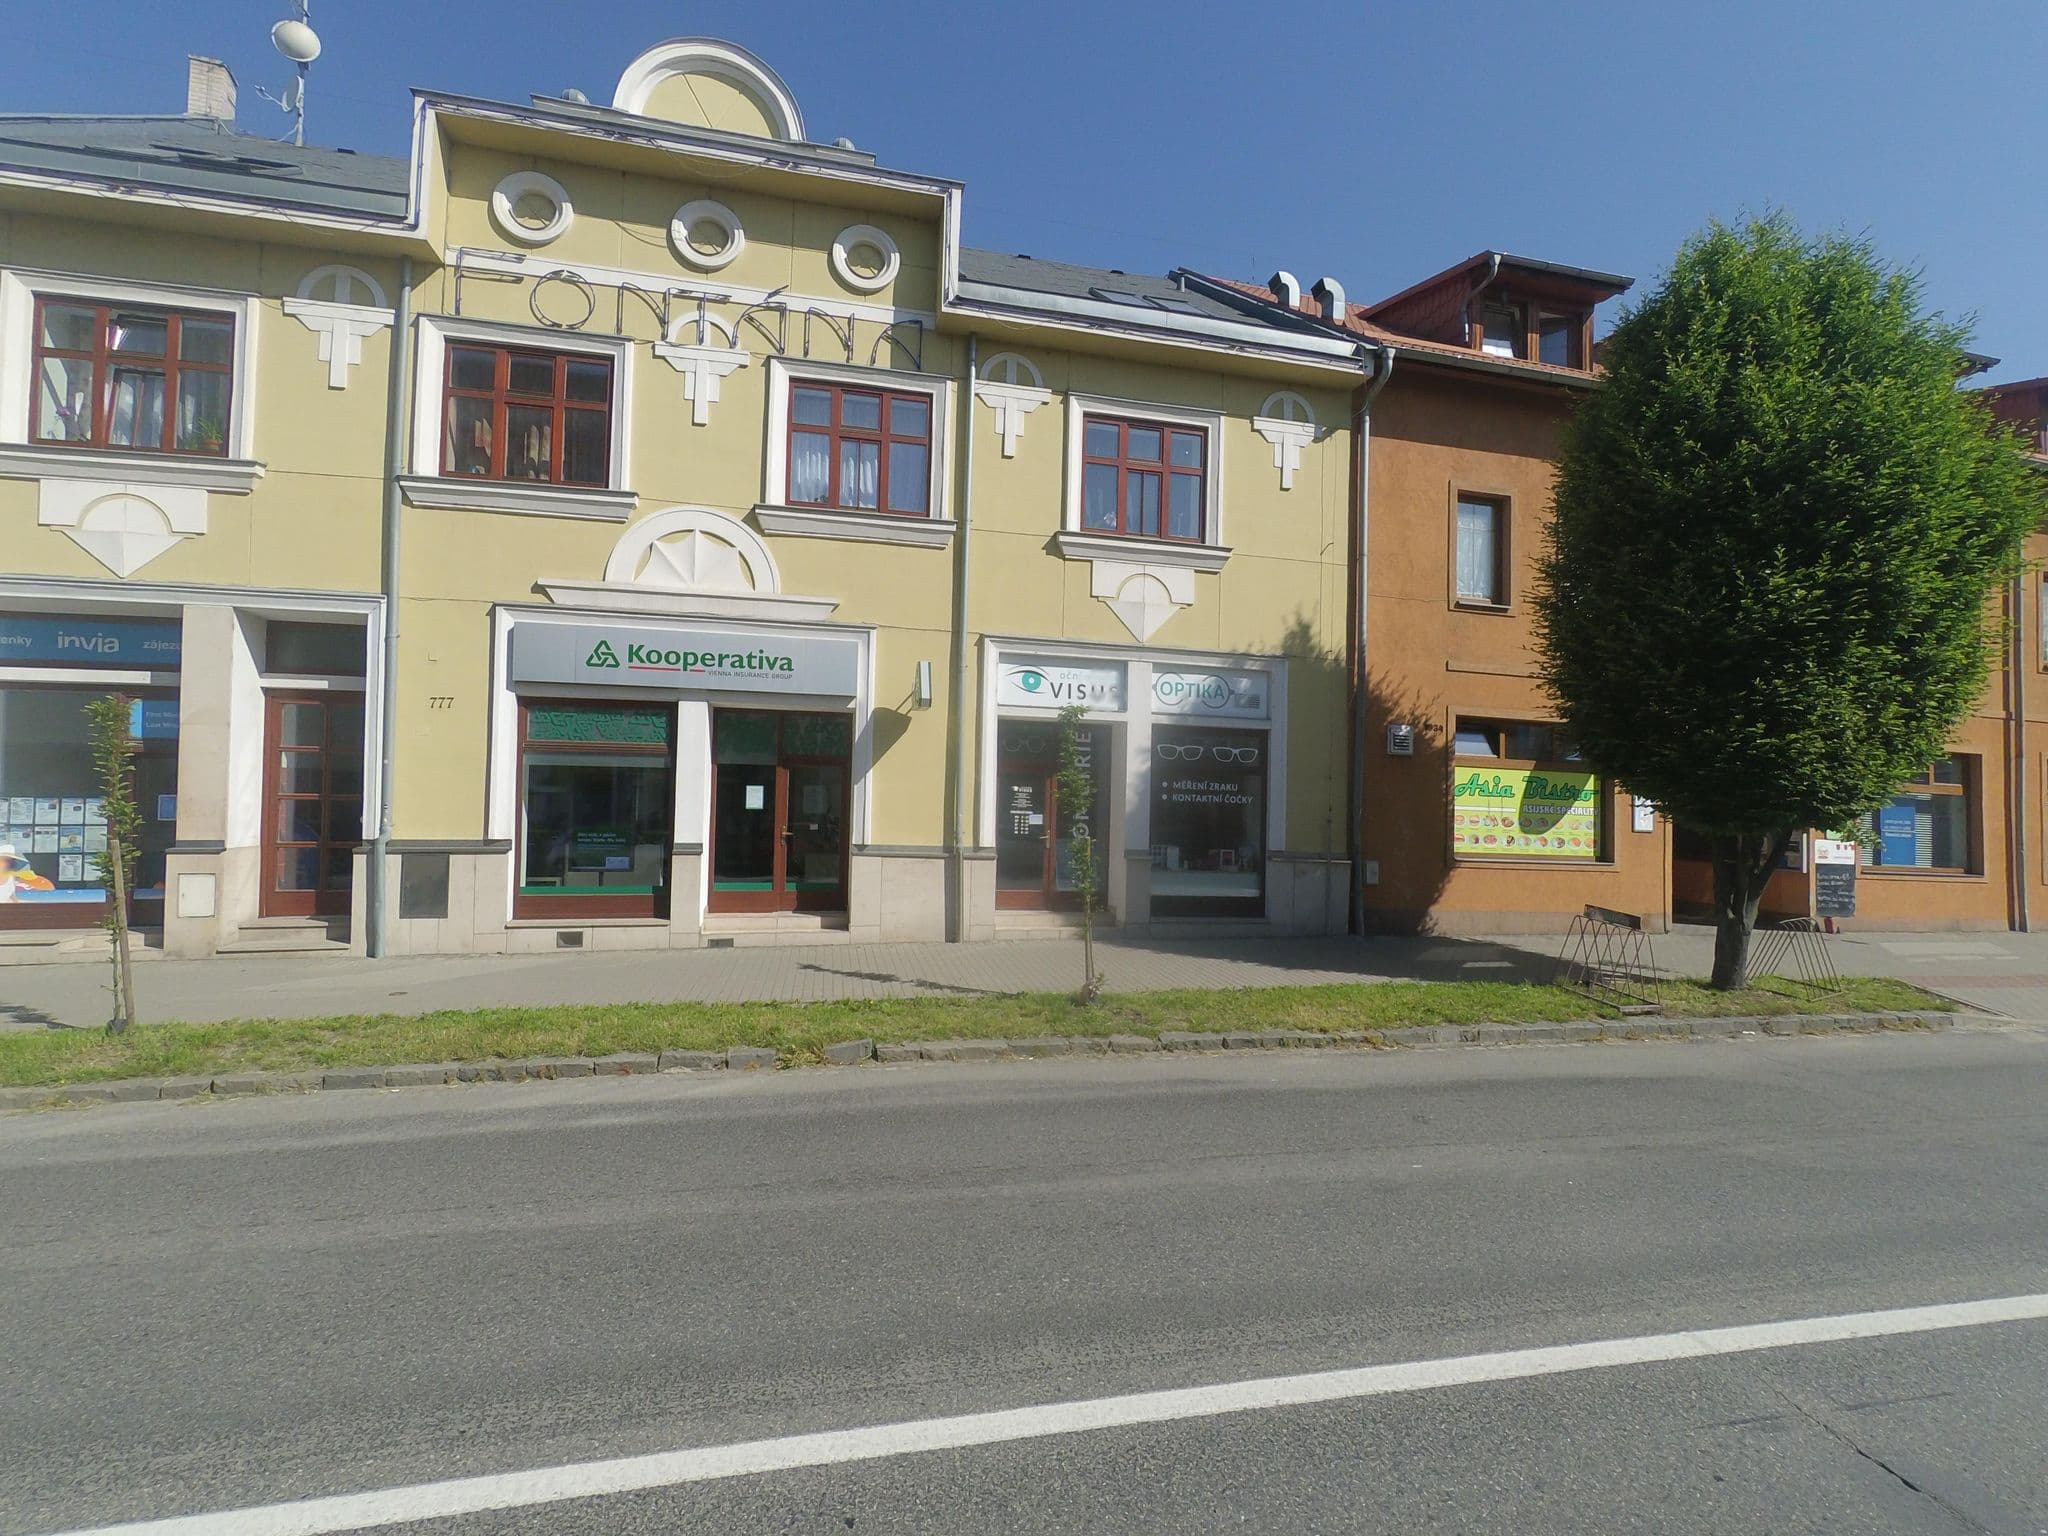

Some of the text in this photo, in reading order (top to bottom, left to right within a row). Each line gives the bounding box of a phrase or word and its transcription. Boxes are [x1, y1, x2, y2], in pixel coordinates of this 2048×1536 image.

[0, 635, 33, 648] enky
[57, 631, 120, 653] invia
[628, 643, 794, 672] Kooperativa
[734, 671, 769, 679] INSURANCE
[1160, 681, 1224, 699] OPTIKA
[430, 696, 454, 709] 777
[1172, 780, 1238, 791] MĚŘENÍ ZRAKU
[1454, 773, 1515, 798] Asia
[1522, 775, 1599, 801] Bistro
[1172, 793, 1253, 804] KONTAKTNÍ ČOČKY
